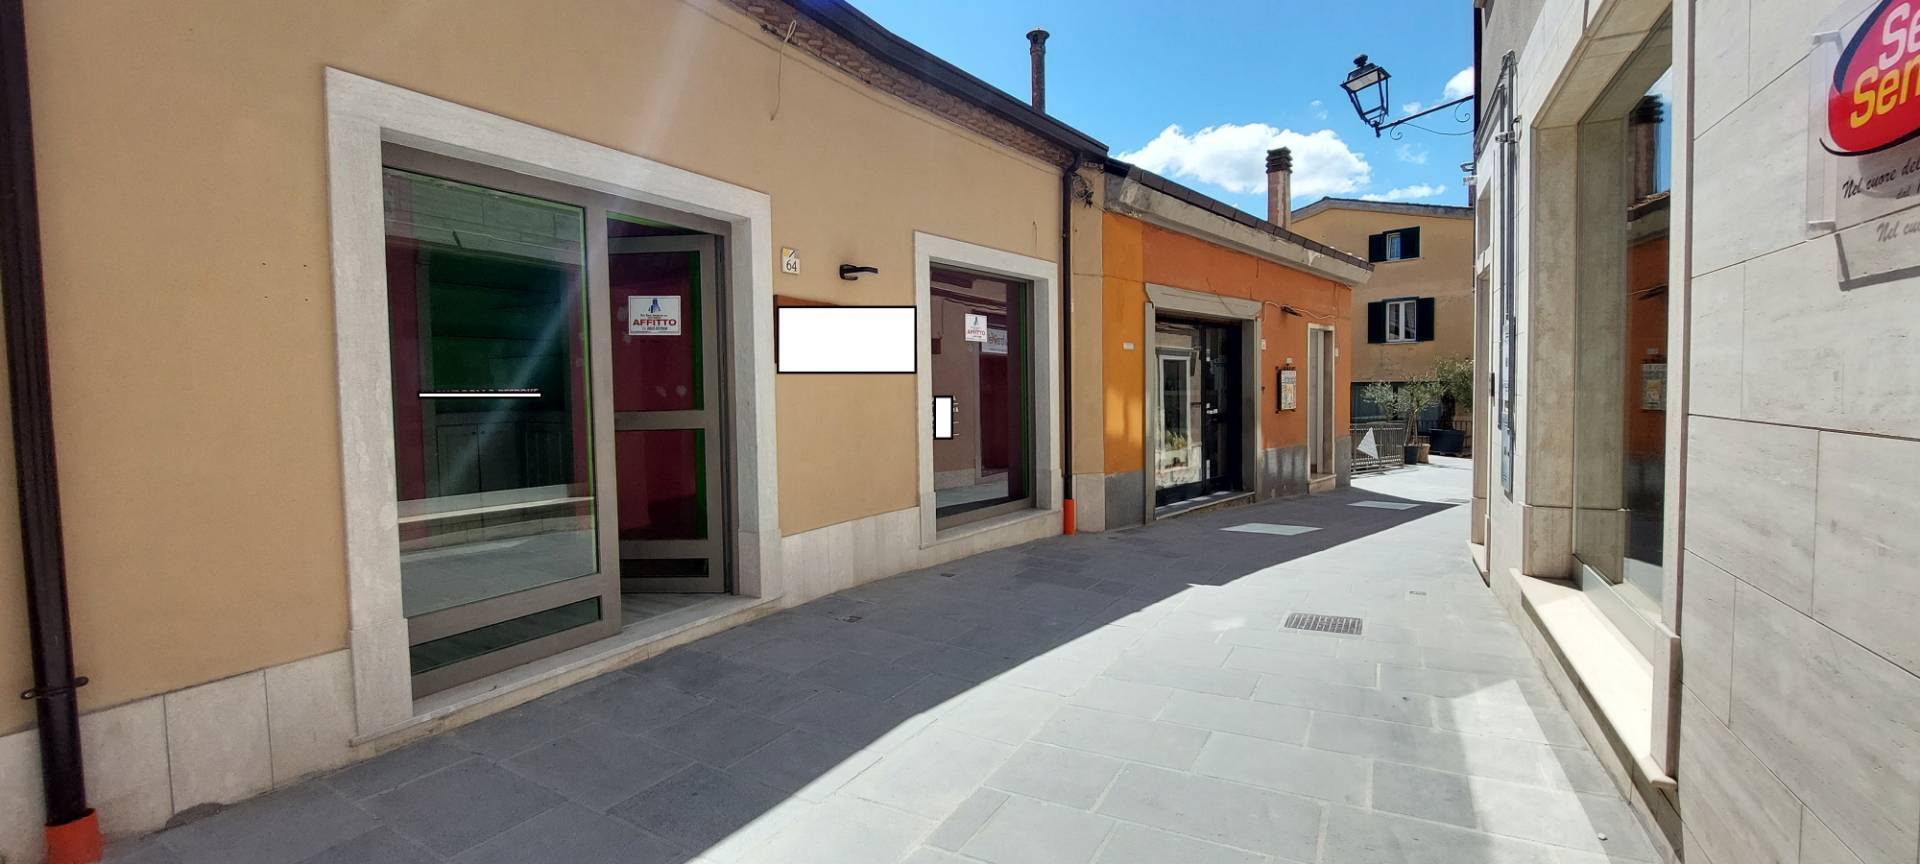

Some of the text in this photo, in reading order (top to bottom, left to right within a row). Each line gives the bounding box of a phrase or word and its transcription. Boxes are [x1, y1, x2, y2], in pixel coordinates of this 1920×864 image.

[1842, 177, 1863, 199] Nel
[1866, 168, 1897, 190] cuore
[786, 258, 797, 272] 64
[633, 318, 677, 327] AFFITTO
